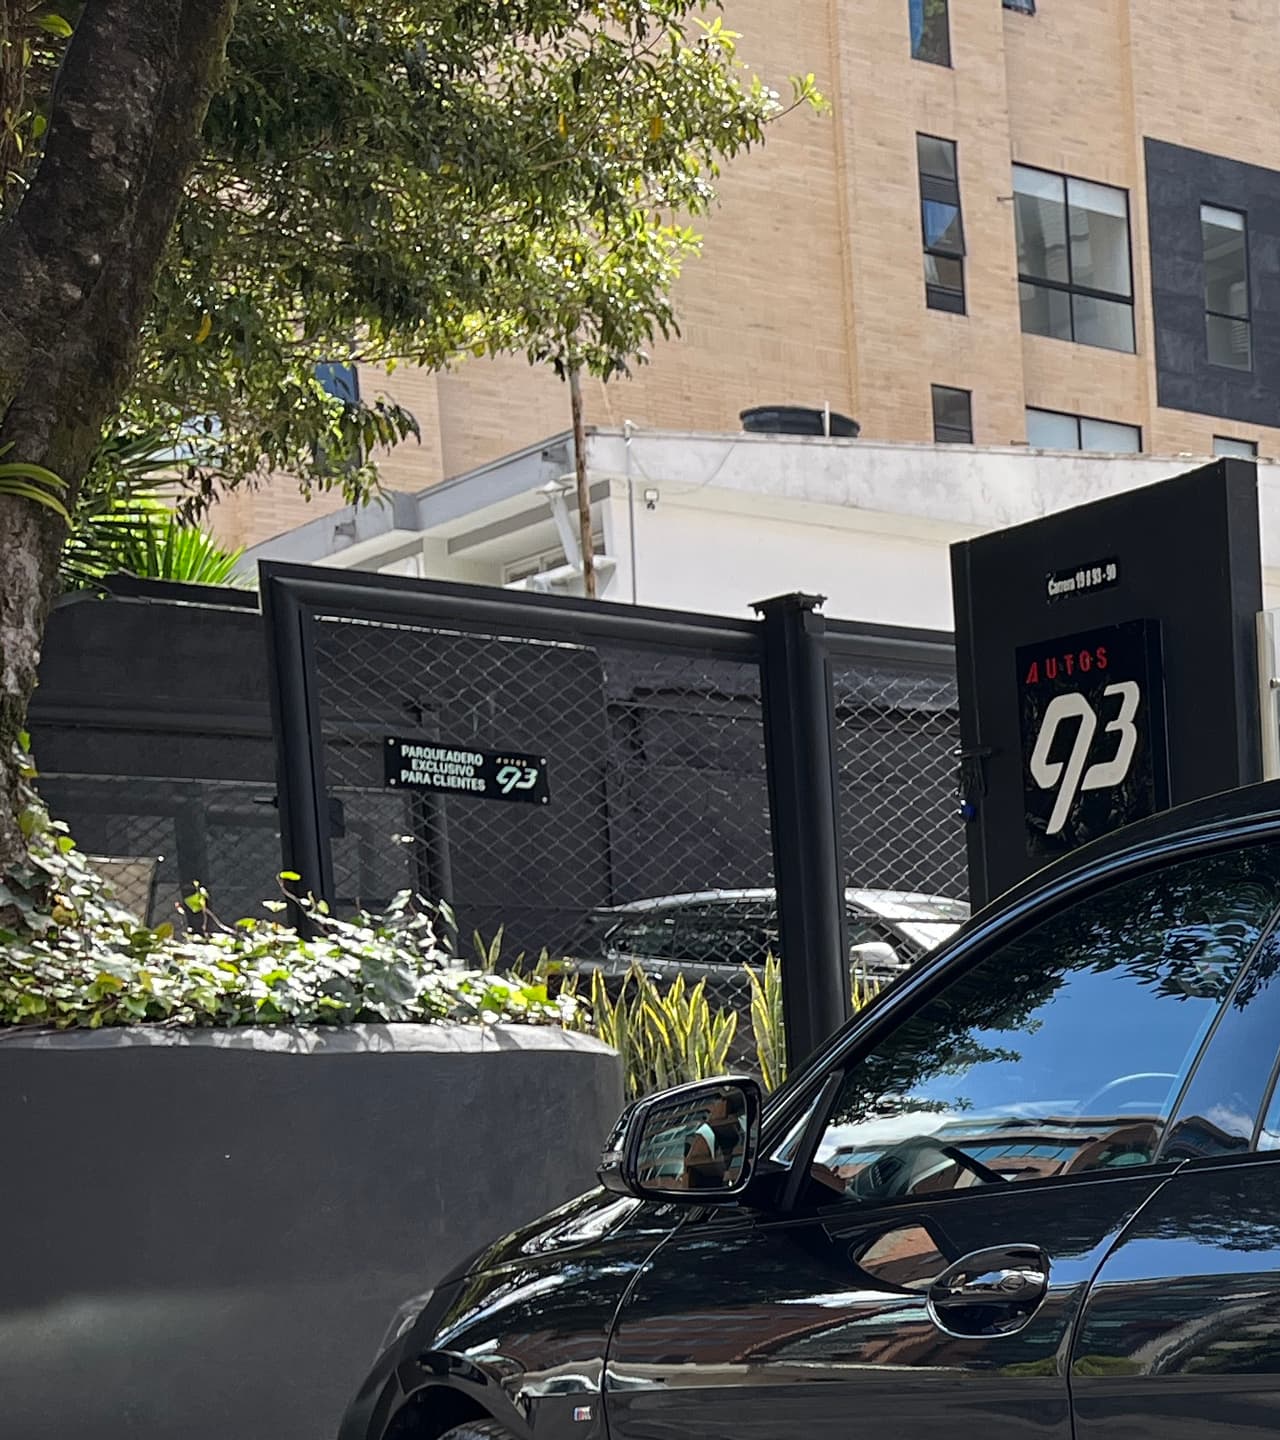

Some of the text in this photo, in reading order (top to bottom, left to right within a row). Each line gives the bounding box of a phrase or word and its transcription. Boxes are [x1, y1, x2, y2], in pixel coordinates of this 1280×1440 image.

[1025, 647, 1109, 685] AUTOS
[400, 744, 484, 767] PARQUEADERO
[411, 757, 475, 778] EXCLUSIVO
[1029, 680, 1141, 836] 93
[400, 769, 487, 793] PARA CLIENTES
[495, 765, 539, 794] 93
